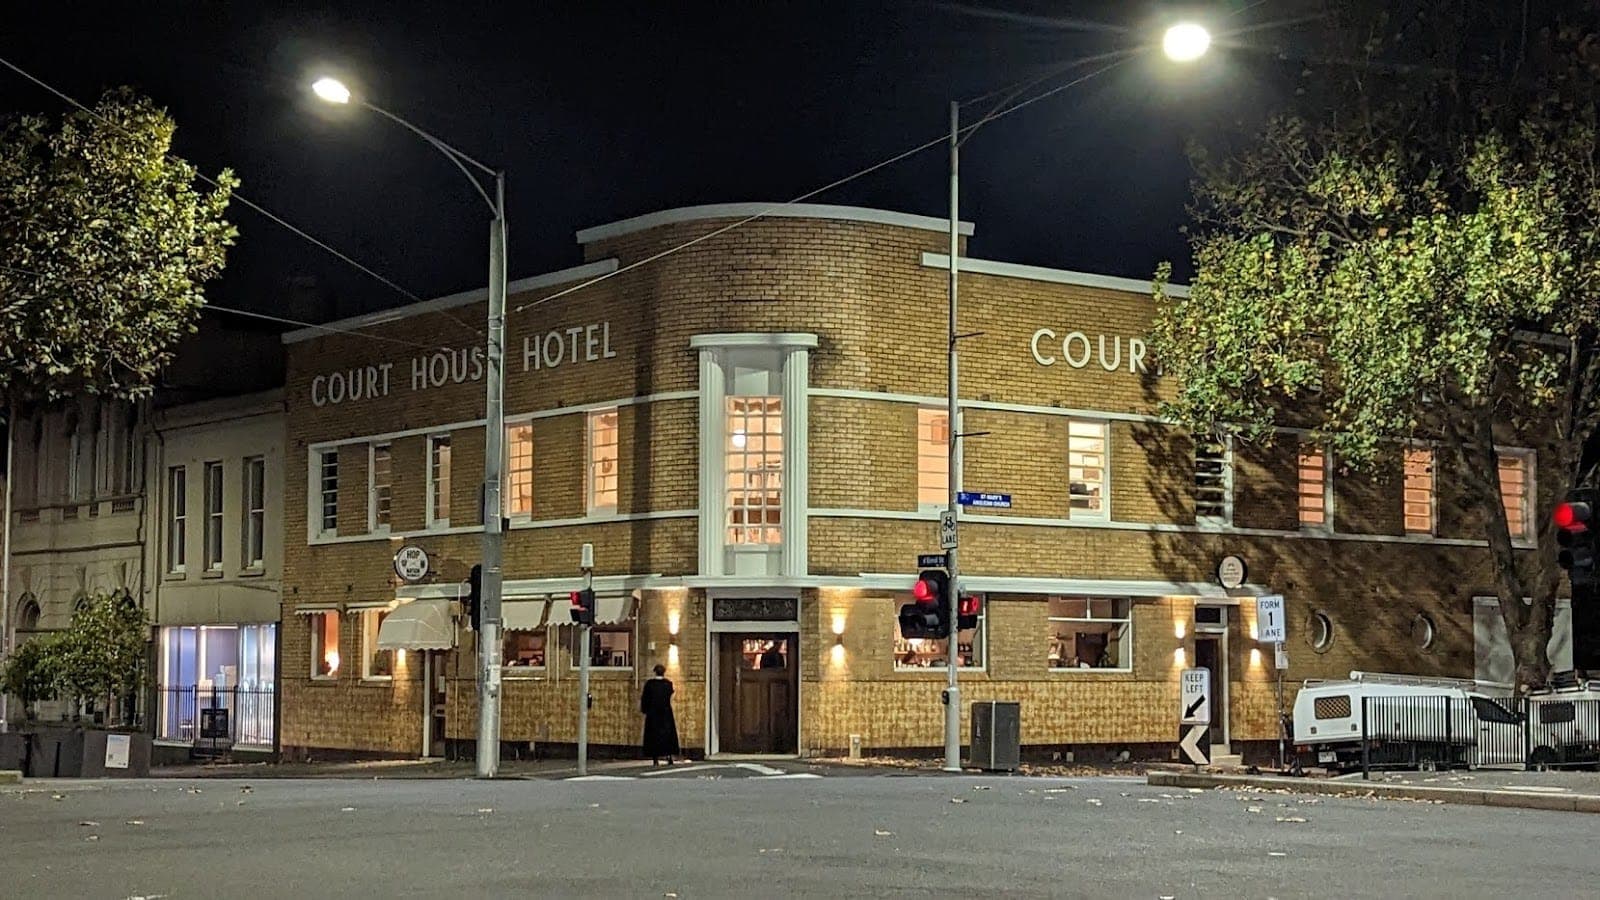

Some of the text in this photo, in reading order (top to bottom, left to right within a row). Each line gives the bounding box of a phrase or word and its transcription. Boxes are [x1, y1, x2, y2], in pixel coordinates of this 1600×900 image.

[1031, 328, 1163, 375] COUR
[311, 321, 617, 407] COURT HOUS HOTEL
[943, 535, 956, 544] LANE
[406, 550, 420, 559] HOP
[1260, 601, 1280, 609] FORM
[1268, 611, 1273, 627] 1
[1185, 673, 1204, 682] KEEP
[1186, 684, 1203, 693] LEFT
